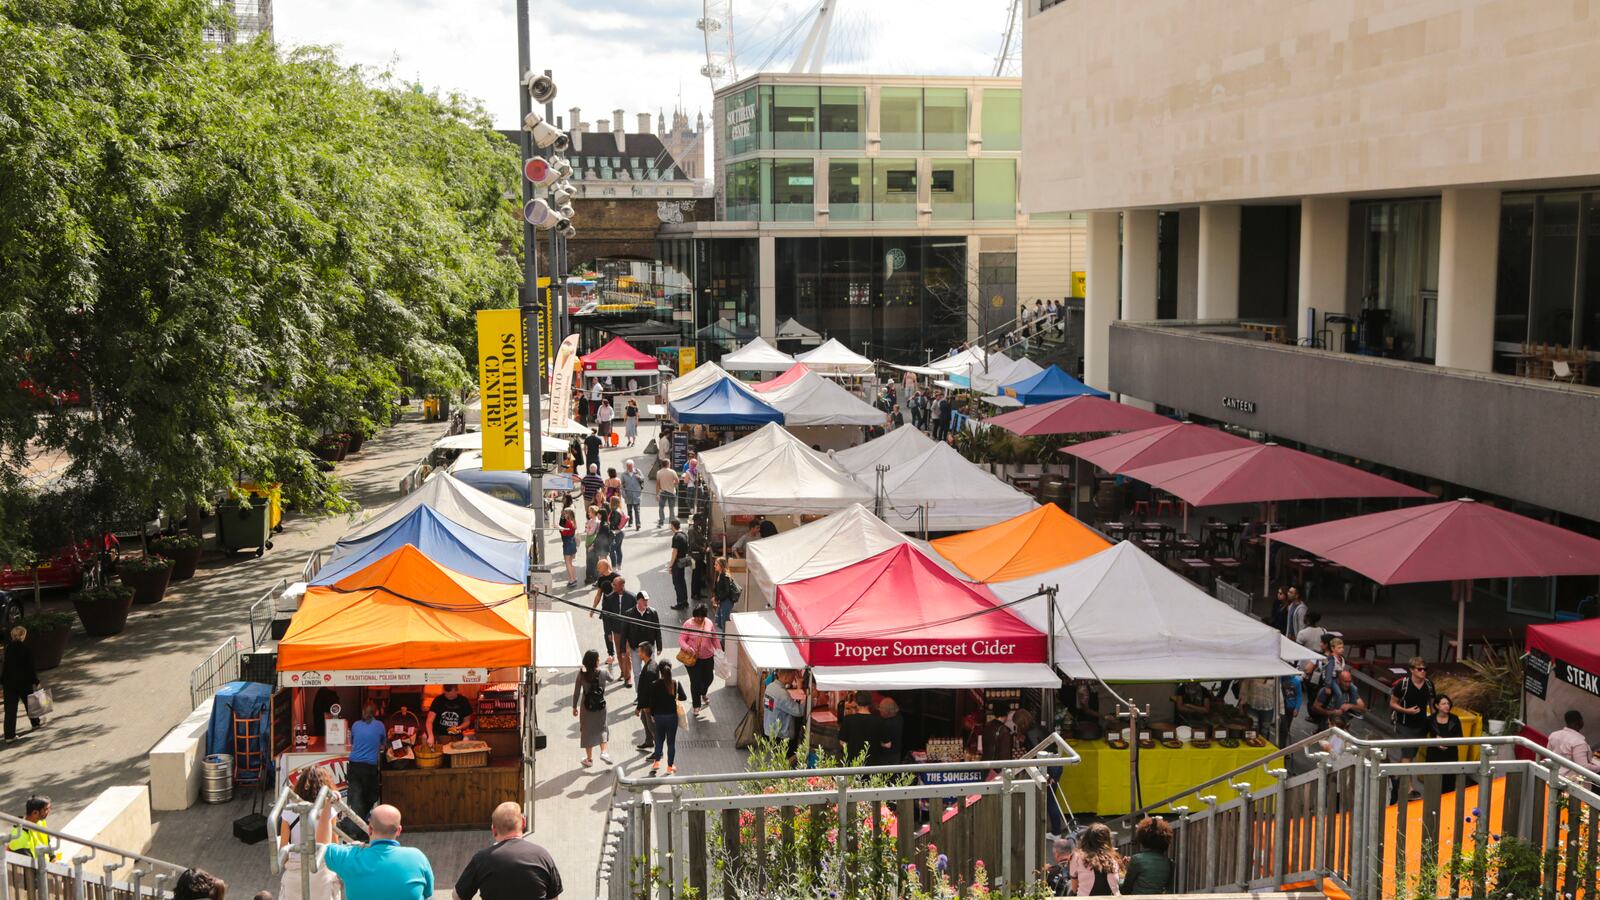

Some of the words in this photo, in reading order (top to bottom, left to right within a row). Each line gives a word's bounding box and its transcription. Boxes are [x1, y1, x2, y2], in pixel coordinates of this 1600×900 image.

[485, 355, 502, 428] CENTRE
[501, 334, 519, 447] SOUTHBANK
[552, 373, 563, 413] GELATO
[1222, 396, 1255, 413] CANTEEN
[834, 642, 889, 661] Proper
[893, 640, 967, 656] Somerset
[971, 639, 1016, 655] Cider
[1566, 664, 1599, 695] STEAK
[927, 773, 941, 782] THE
